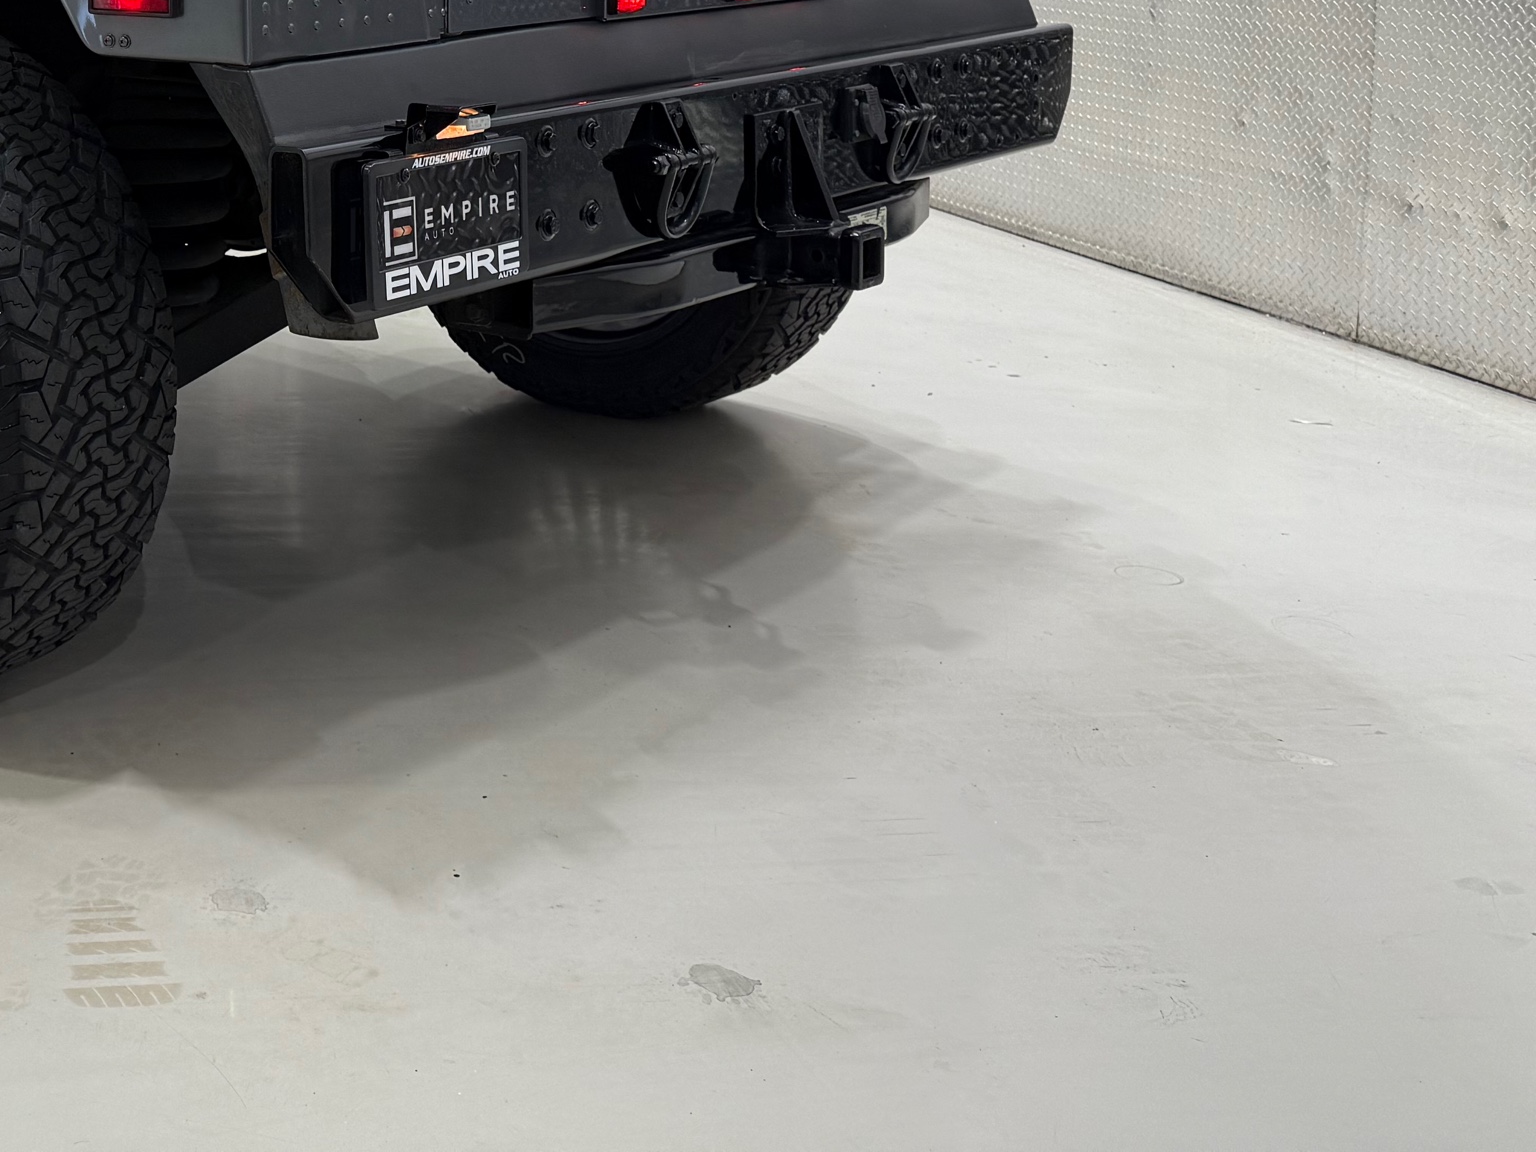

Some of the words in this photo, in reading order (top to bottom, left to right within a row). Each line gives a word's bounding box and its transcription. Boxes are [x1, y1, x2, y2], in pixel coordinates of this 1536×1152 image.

[412, 145, 492, 169] AUTOSEMPIRE.COM
[424, 190, 516, 230] EMPIRE
[424, 226, 456, 242] AUTO
[385, 240, 521, 301] EMPIRE
[498, 268, 520, 280] AUTO
